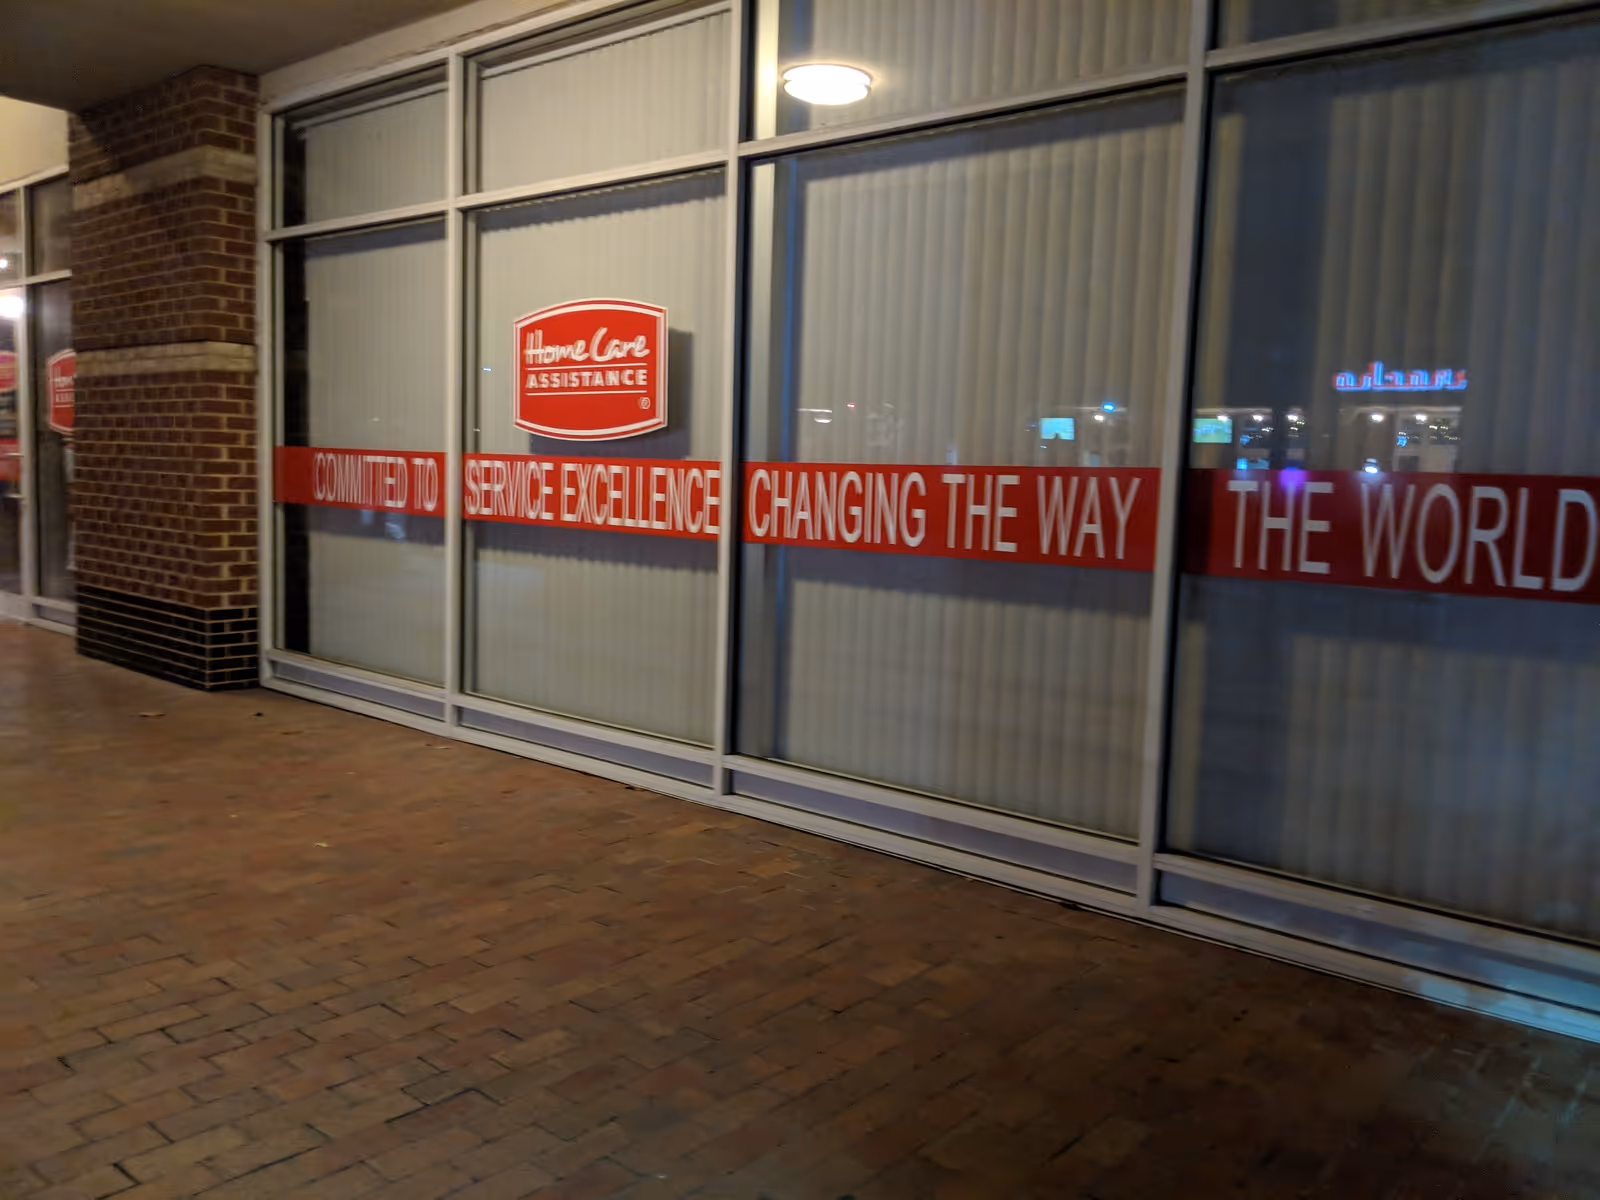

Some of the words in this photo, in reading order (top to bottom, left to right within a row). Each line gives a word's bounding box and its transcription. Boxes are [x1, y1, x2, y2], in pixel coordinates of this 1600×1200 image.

[524, 329, 589, 364] Home
[588, 327, 650, 362] Care
[525, 369, 648, 389] ASSISTANCE
[312, 452, 408, 508] COMMITTED
[411, 457, 439, 512] TO
[464, 459, 554, 521] SERVICE
[560, 462, 721, 535] EXCELLENCE
[748, 468, 927, 548] CHANGING
[941, 473, 1020, 553] THE
[1036, 474, 1142, 560] WAY
[1227, 480, 1334, 575] THE
[1360, 482, 1599, 593] WORLD
